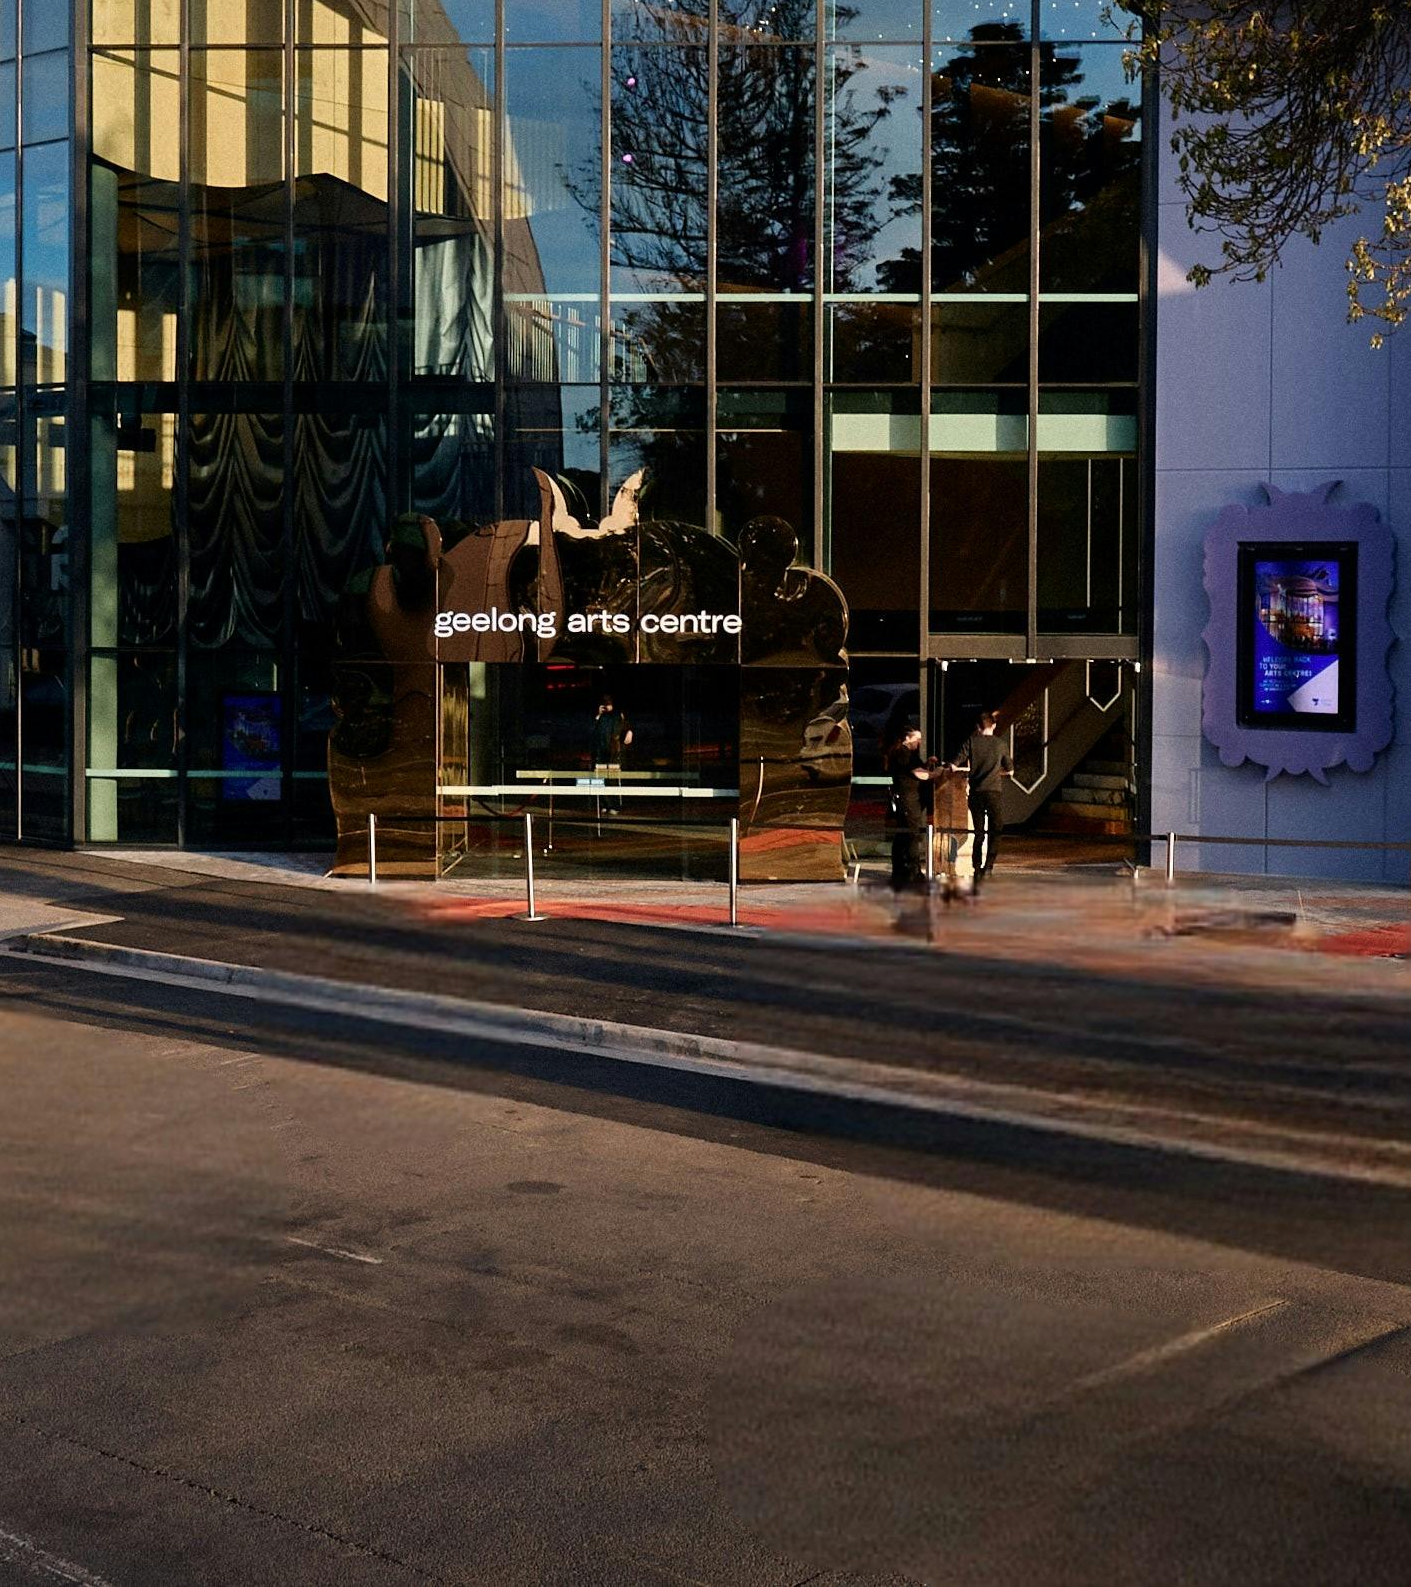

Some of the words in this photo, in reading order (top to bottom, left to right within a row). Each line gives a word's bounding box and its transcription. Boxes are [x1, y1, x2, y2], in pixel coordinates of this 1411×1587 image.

[434, 607, 557, 638] geelong
[567, 610, 631, 634] arts
[640, 610, 742, 634] centre
[1259, 662, 1268, 670] TO
